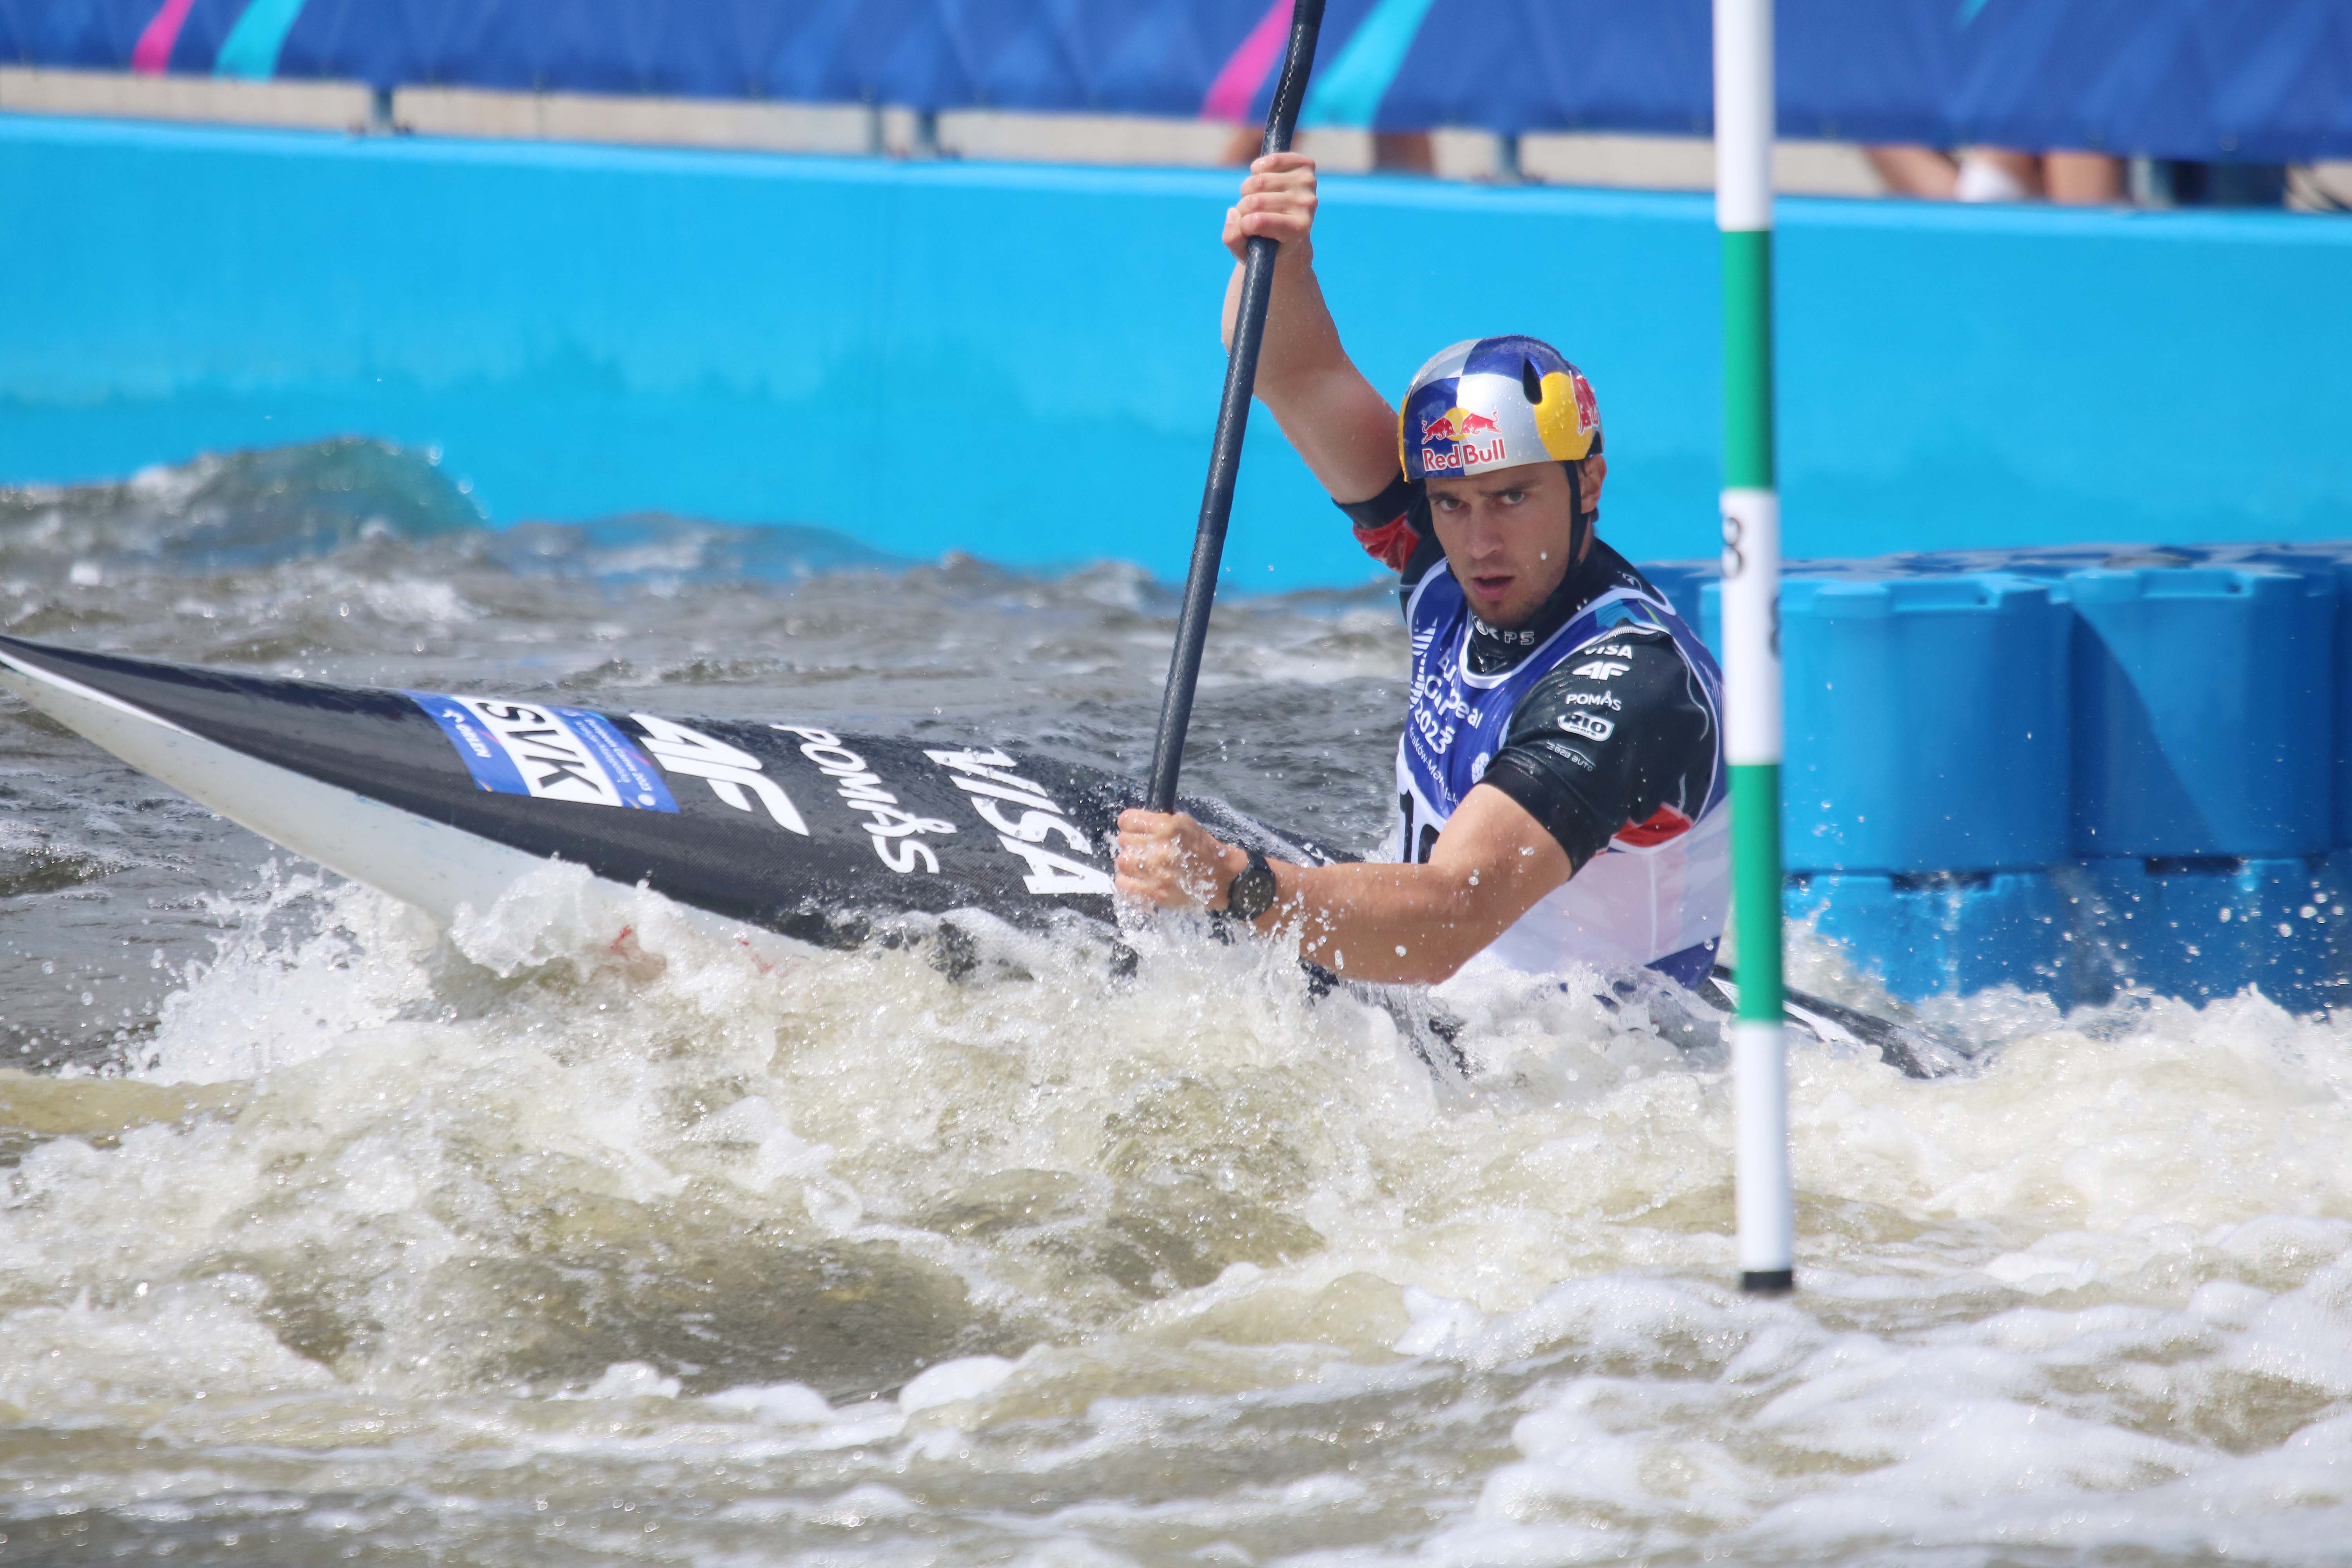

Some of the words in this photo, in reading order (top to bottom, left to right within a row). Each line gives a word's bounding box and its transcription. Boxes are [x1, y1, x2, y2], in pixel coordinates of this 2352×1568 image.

[1422, 447, 1460, 471] Red
[1462, 439, 1506, 465] Bull
[1572, 661, 1630, 681] 4F
[456, 722, 492, 759] ORLEN
[477, 703, 603, 795] SVK
[1554, 746, 1571, 759] B2B
[629, 714, 809, 836] 4F
[923, 748, 1117, 895] VISA
